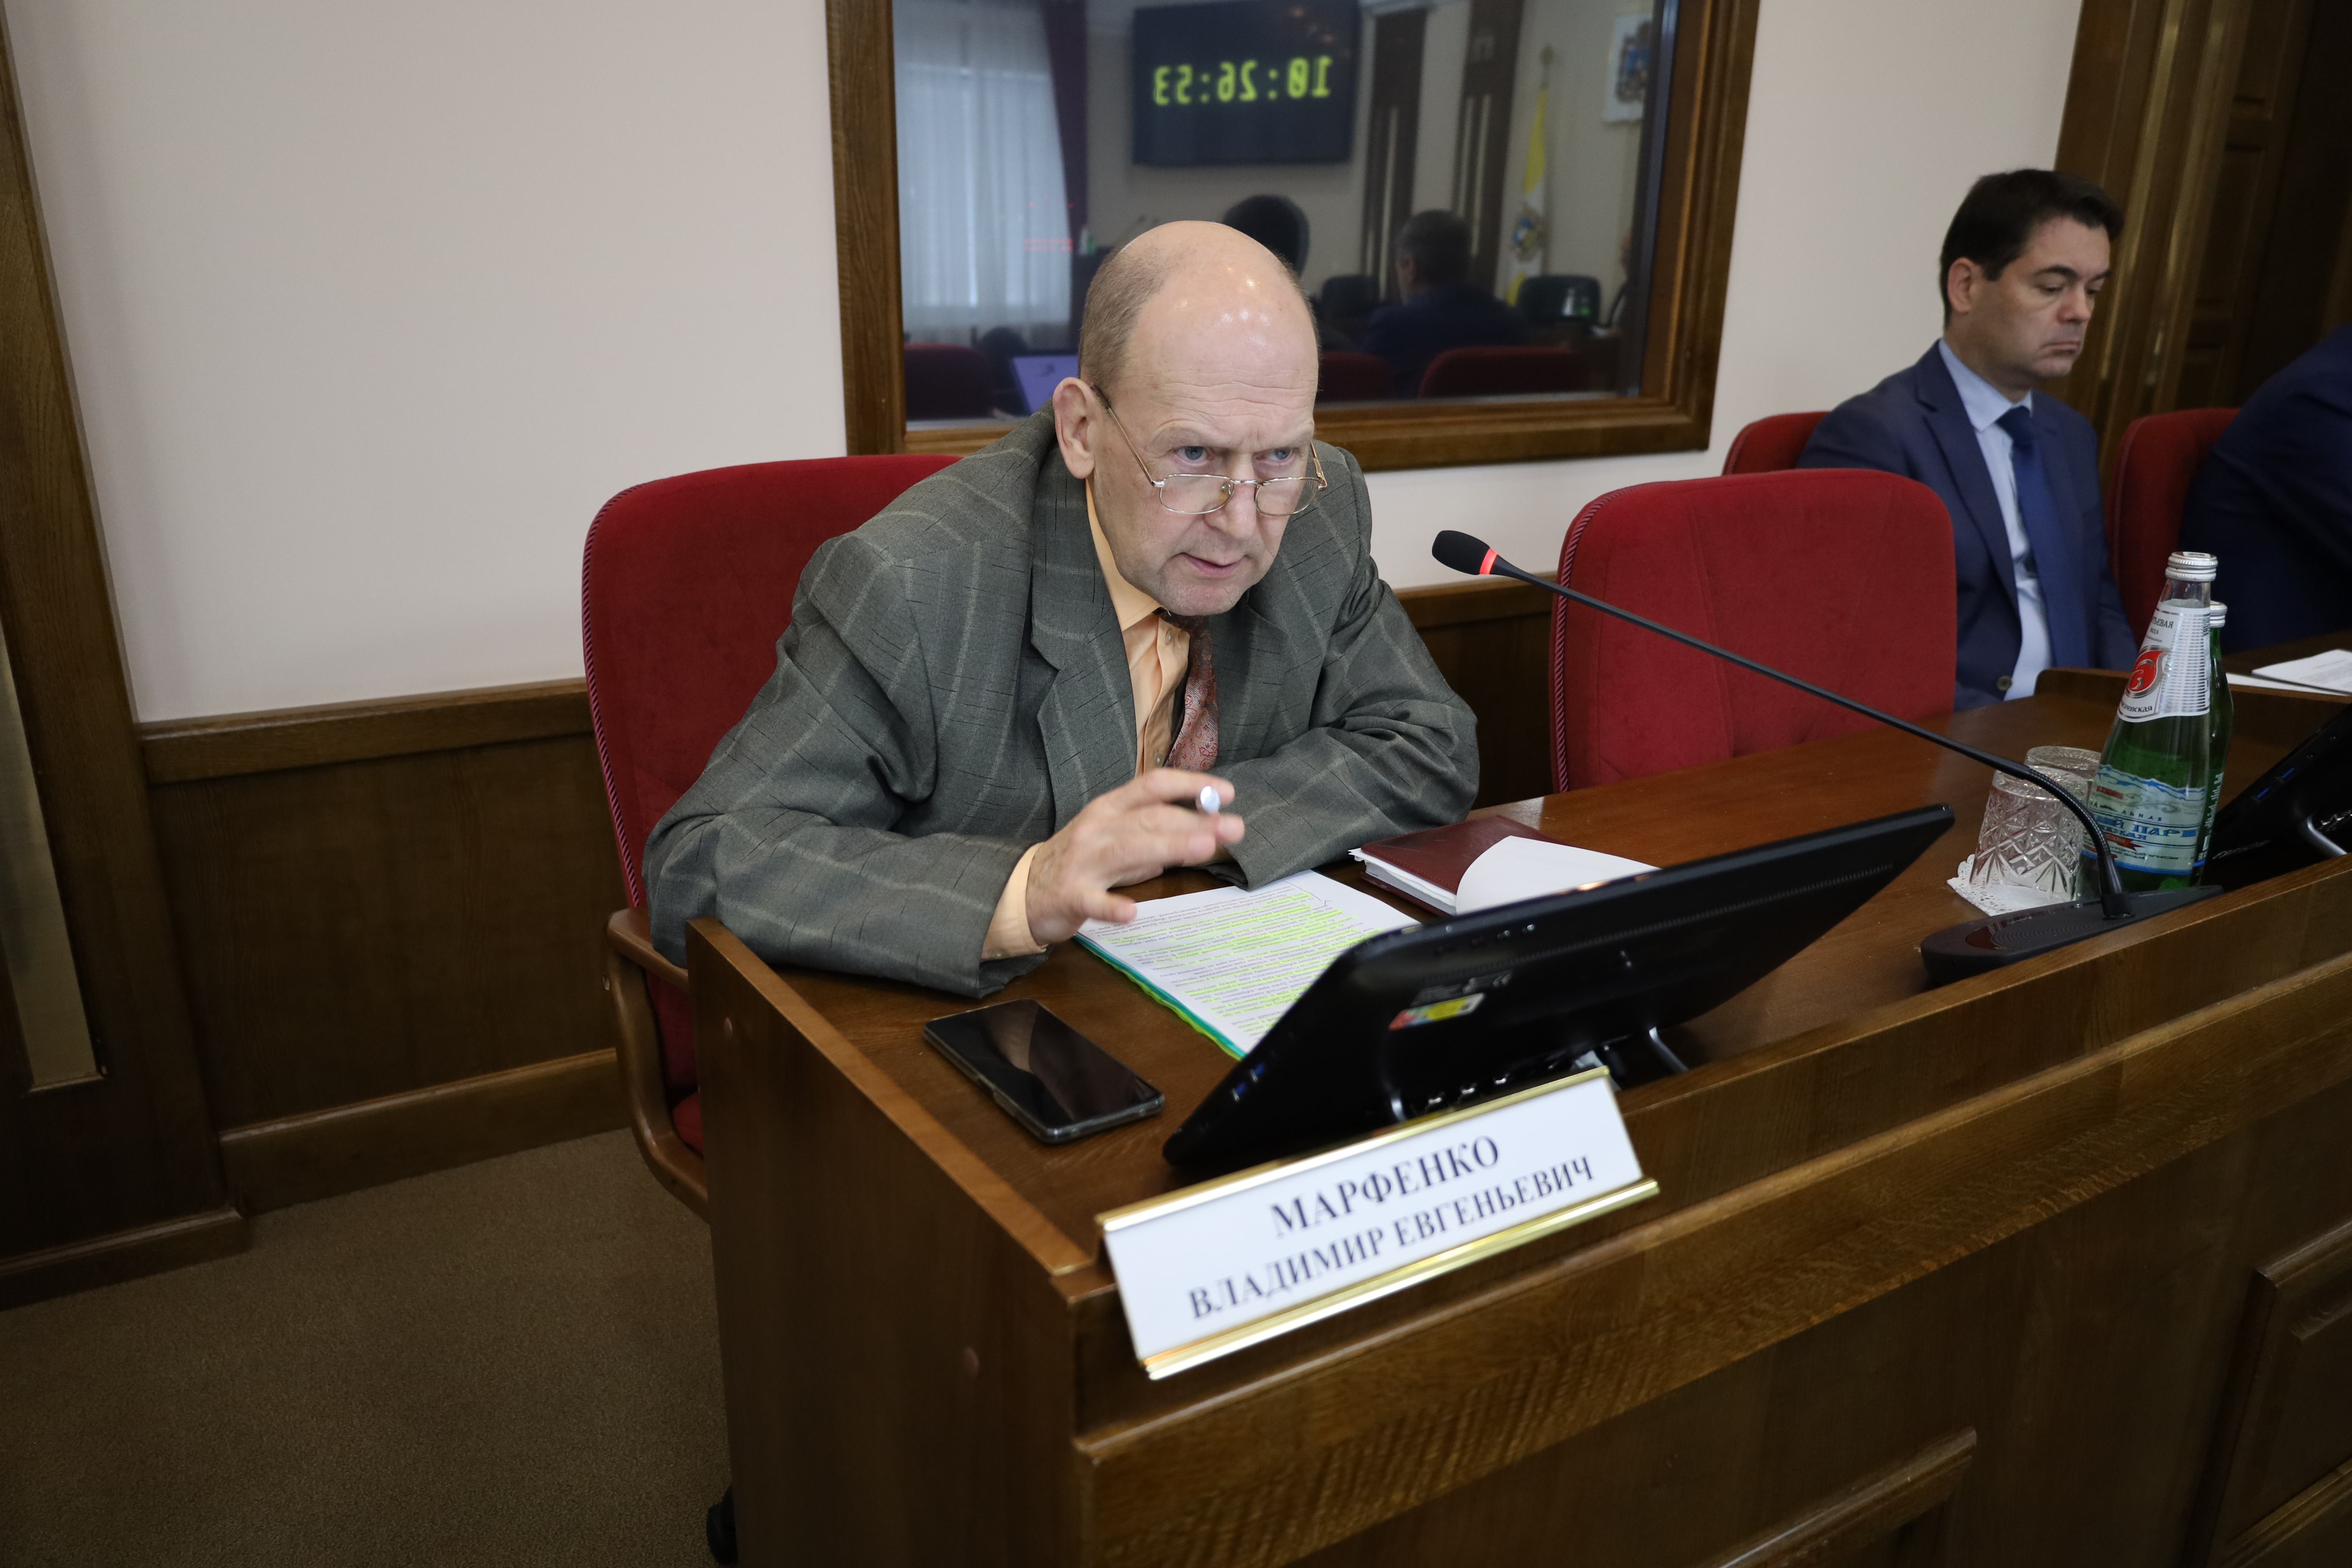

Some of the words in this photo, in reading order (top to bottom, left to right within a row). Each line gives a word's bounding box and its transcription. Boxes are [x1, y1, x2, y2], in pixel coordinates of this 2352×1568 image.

[1188, 1228, 1384, 1319] ВЛАДИМИР
[1394, 1155, 1594, 1248] ЕВГЕНЬЕВИЧ
[1271, 1135, 1499, 1237] МАРФЕНКО
